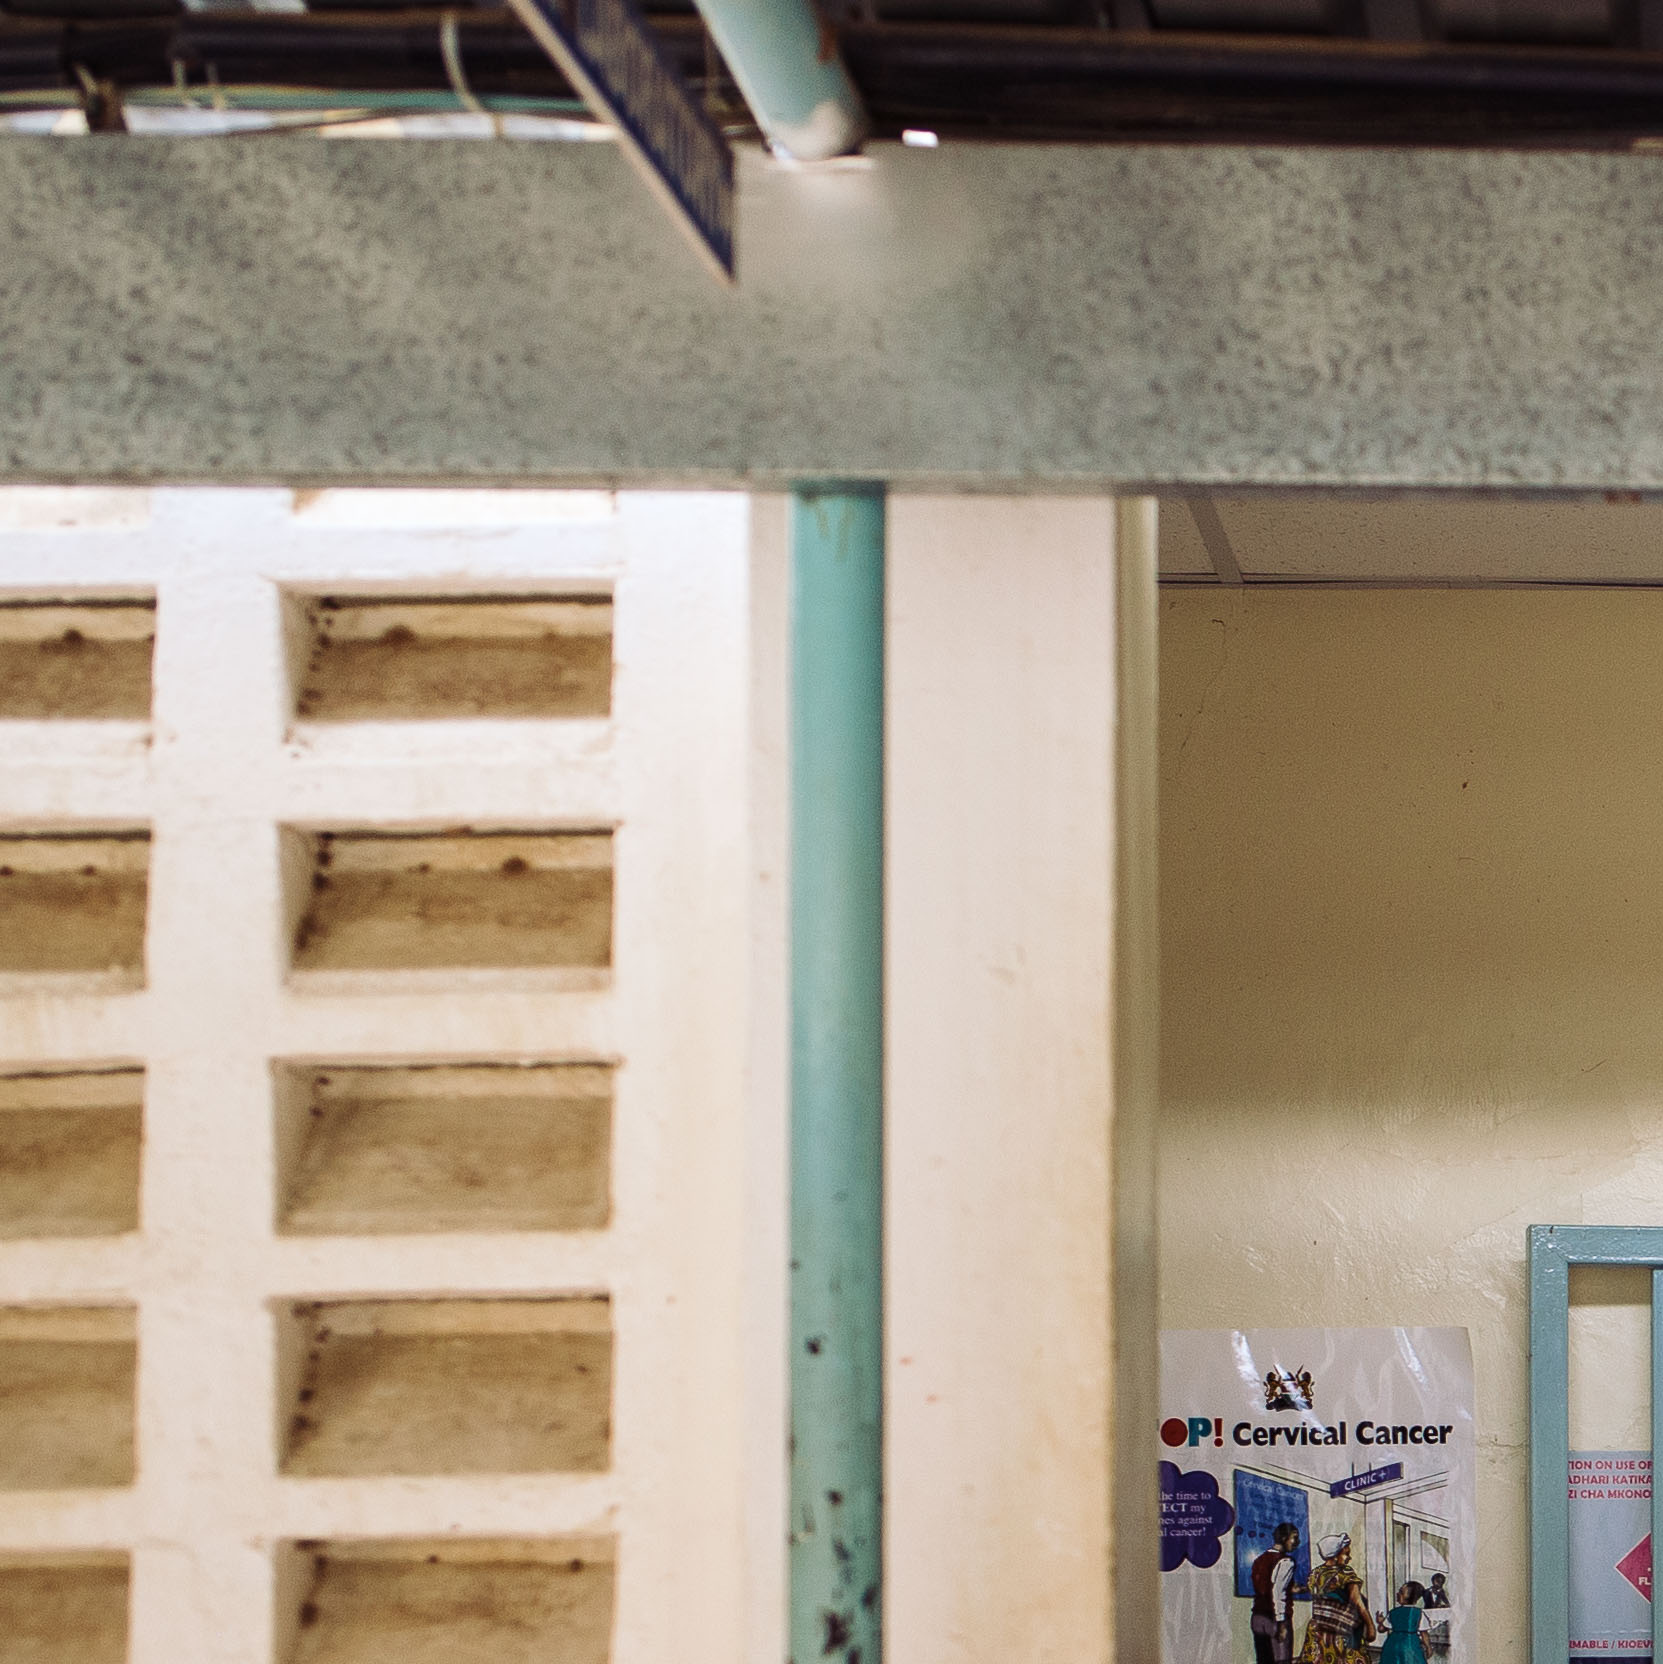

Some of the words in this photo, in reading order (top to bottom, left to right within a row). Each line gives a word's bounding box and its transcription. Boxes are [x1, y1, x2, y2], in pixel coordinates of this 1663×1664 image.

[1160, 1417, 1223, 1447] OP!
[1233, 1421, 1346, 1446] Cervical
[1356, 1421, 1453, 1445] Cancer
[1595, 1461, 1613, 1470] ON
[1615, 1461, 1635, 1470] USE
[1344, 1473, 1377, 1492] CLINIC
[1176, 1491, 1198, 1500] time
[1201, 1492, 1211, 1500] to
[1580, 1489, 1604, 1499] CHA
[1607, 1489, 1651, 1499] MKONO
[1161, 1503, 1187, 1513] ECT
[1191, 1506, 1206, 1514] my
[1178, 1514, 1213, 1526] against
[1170, 1526, 1206, 1537] cancer!
